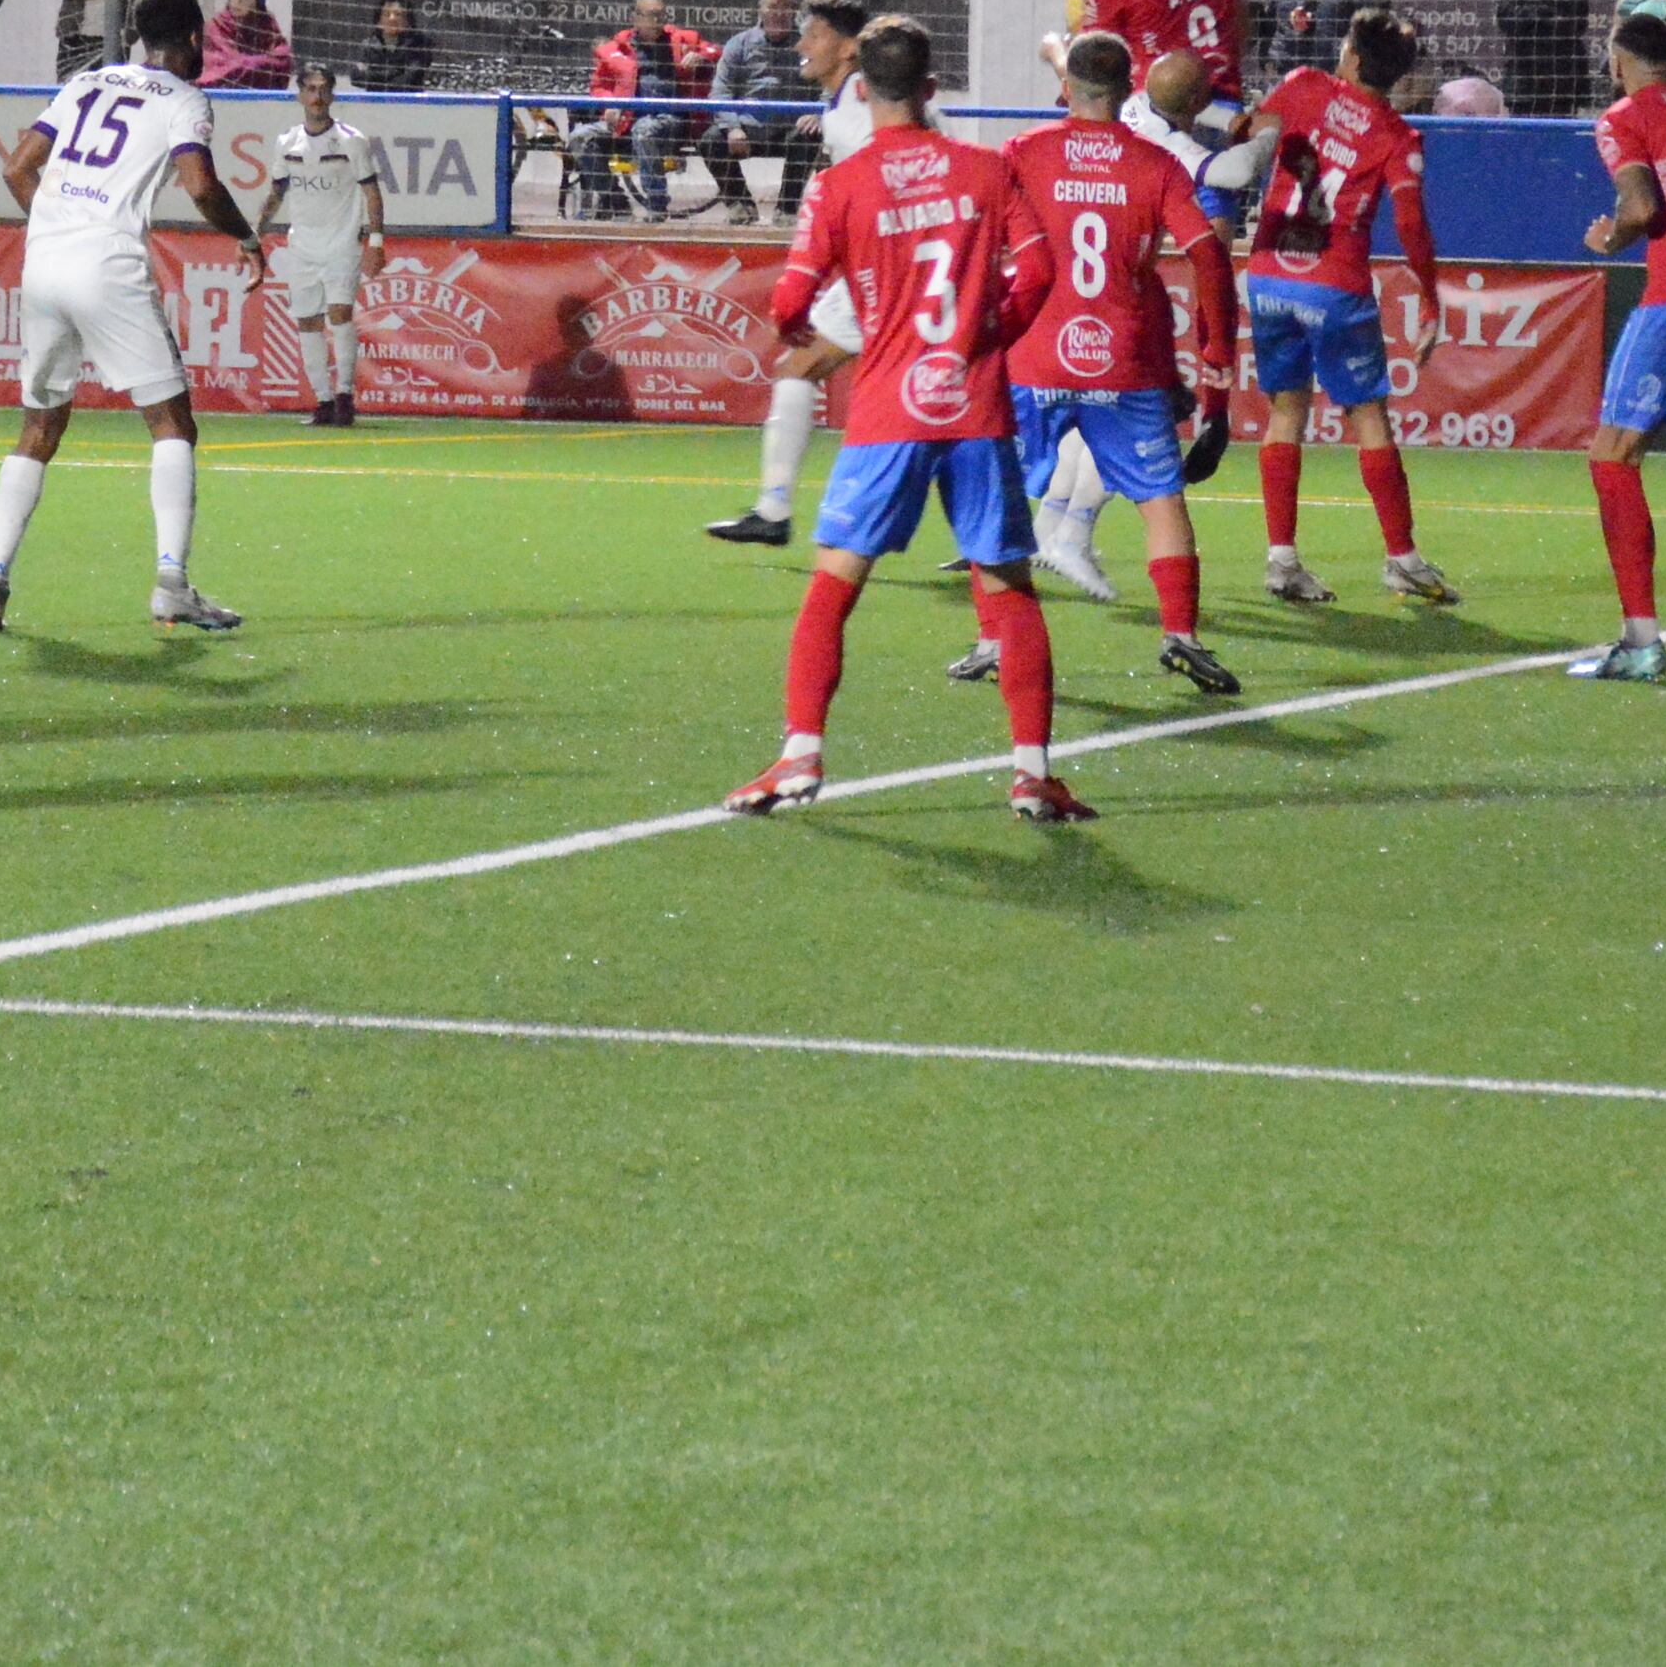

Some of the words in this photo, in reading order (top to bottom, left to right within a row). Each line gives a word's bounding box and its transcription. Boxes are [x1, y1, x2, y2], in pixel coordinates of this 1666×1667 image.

[546, 3, 569, 21] 22
[573, 4, 632, 23] PLANT
[1445, 35, 1482, 55] 547
[58, 87, 147, 169] 15
[1053, 178, 1128, 207] CERVERA
[877, 198, 956, 238] ALVARO
[1071, 210, 1108, 300] 8
[912, 238, 957, 346] 3
[579, 285, 750, 342] BARBERIA
[615, 349, 720, 370] MARRAKECH
[1067, 348, 1112, 361] SALUD
[200, 369, 249, 390] MAR
[490, 394, 506, 406] DE
[635, 397, 671, 412] TORRE
[674, 399, 695, 412] DEL
[699, 400, 727, 413] MAR
[1439, 411, 1517, 449] 969
